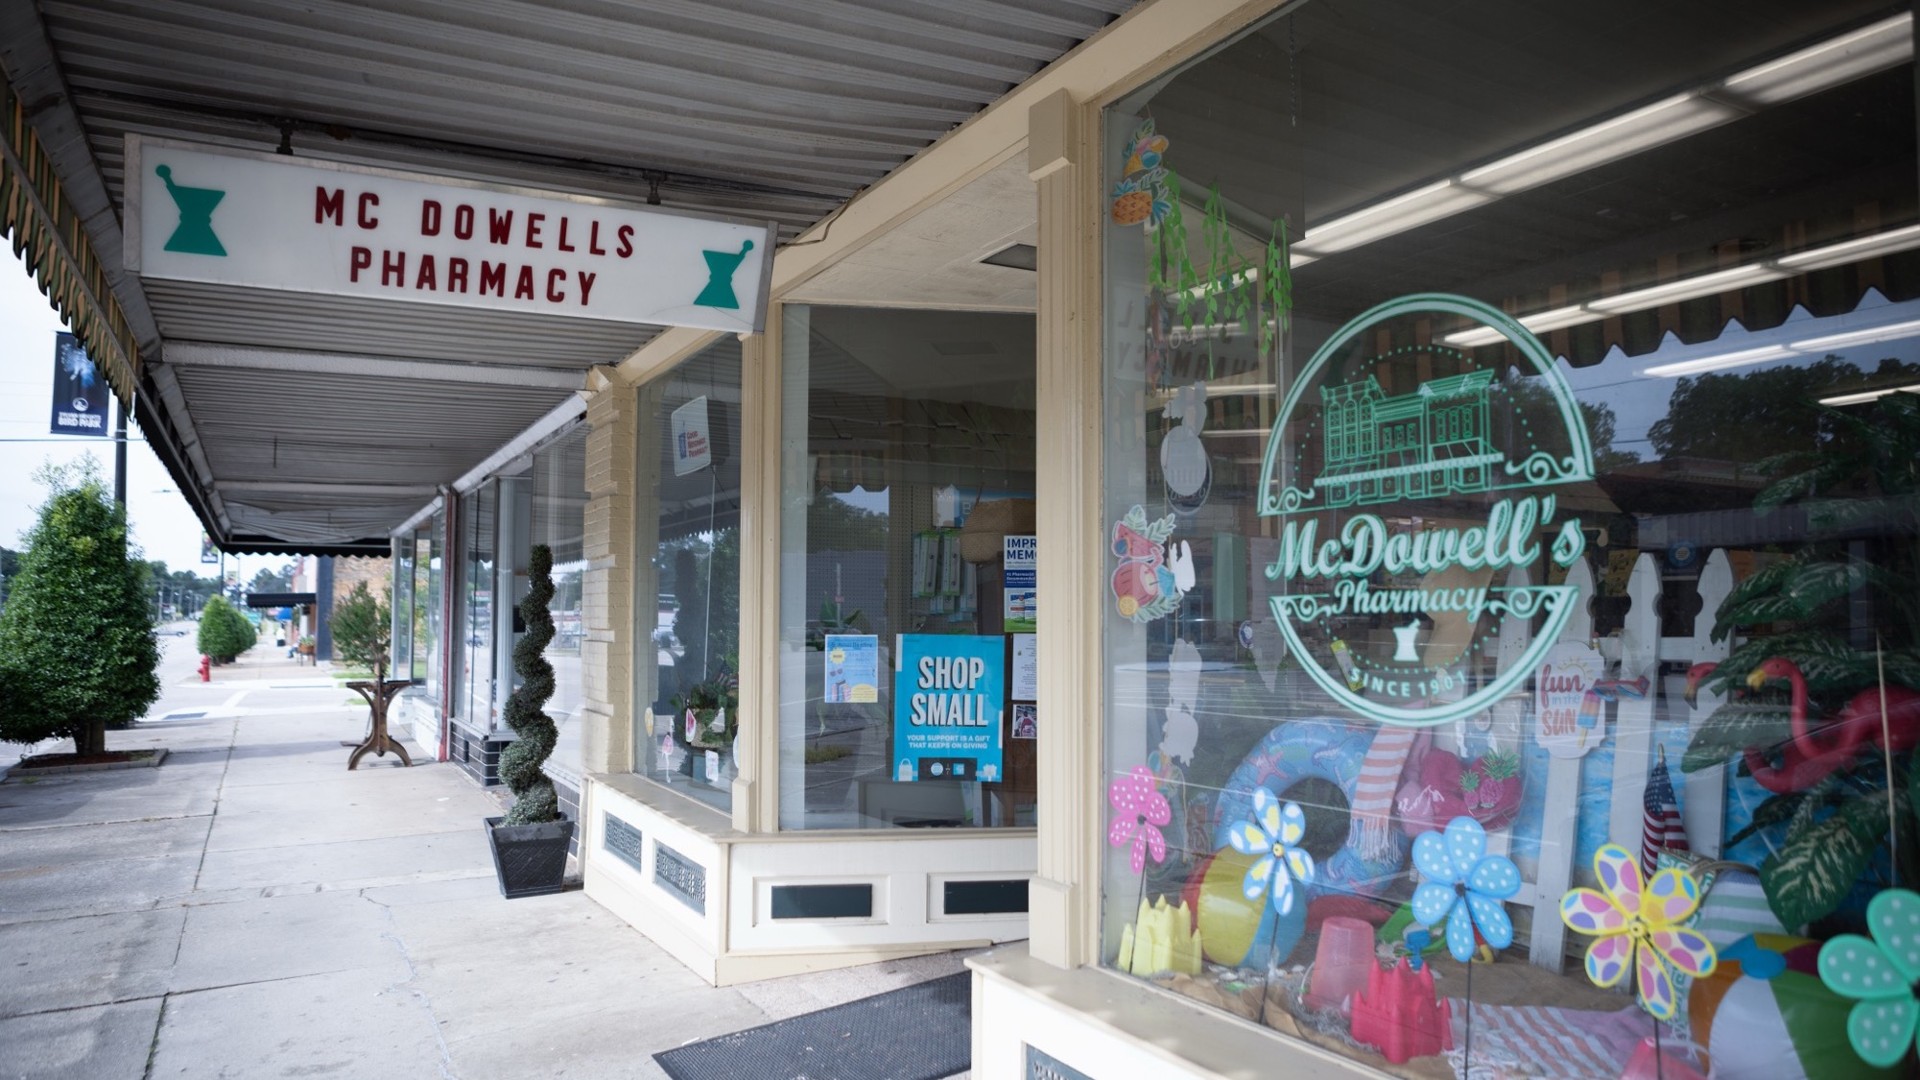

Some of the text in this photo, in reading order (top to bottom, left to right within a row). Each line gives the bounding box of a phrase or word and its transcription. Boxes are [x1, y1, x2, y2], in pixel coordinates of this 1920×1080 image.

[315, 186, 634, 258] MC DOWELLS
[350, 246, 596, 306] PHARMACY
[1007, 550, 1036, 560] MEM
[1265, 493, 1586, 580] McDowell's
[1333, 578, 1487, 623] Pharmacy
[918, 656, 984, 690] SHOP
[1350, 666, 1465, 697] SINCE 1901
[1541, 664, 1585, 709] fun
[909, 693, 988, 727] SMALL
[1542, 708, 1576, 736] SUN
